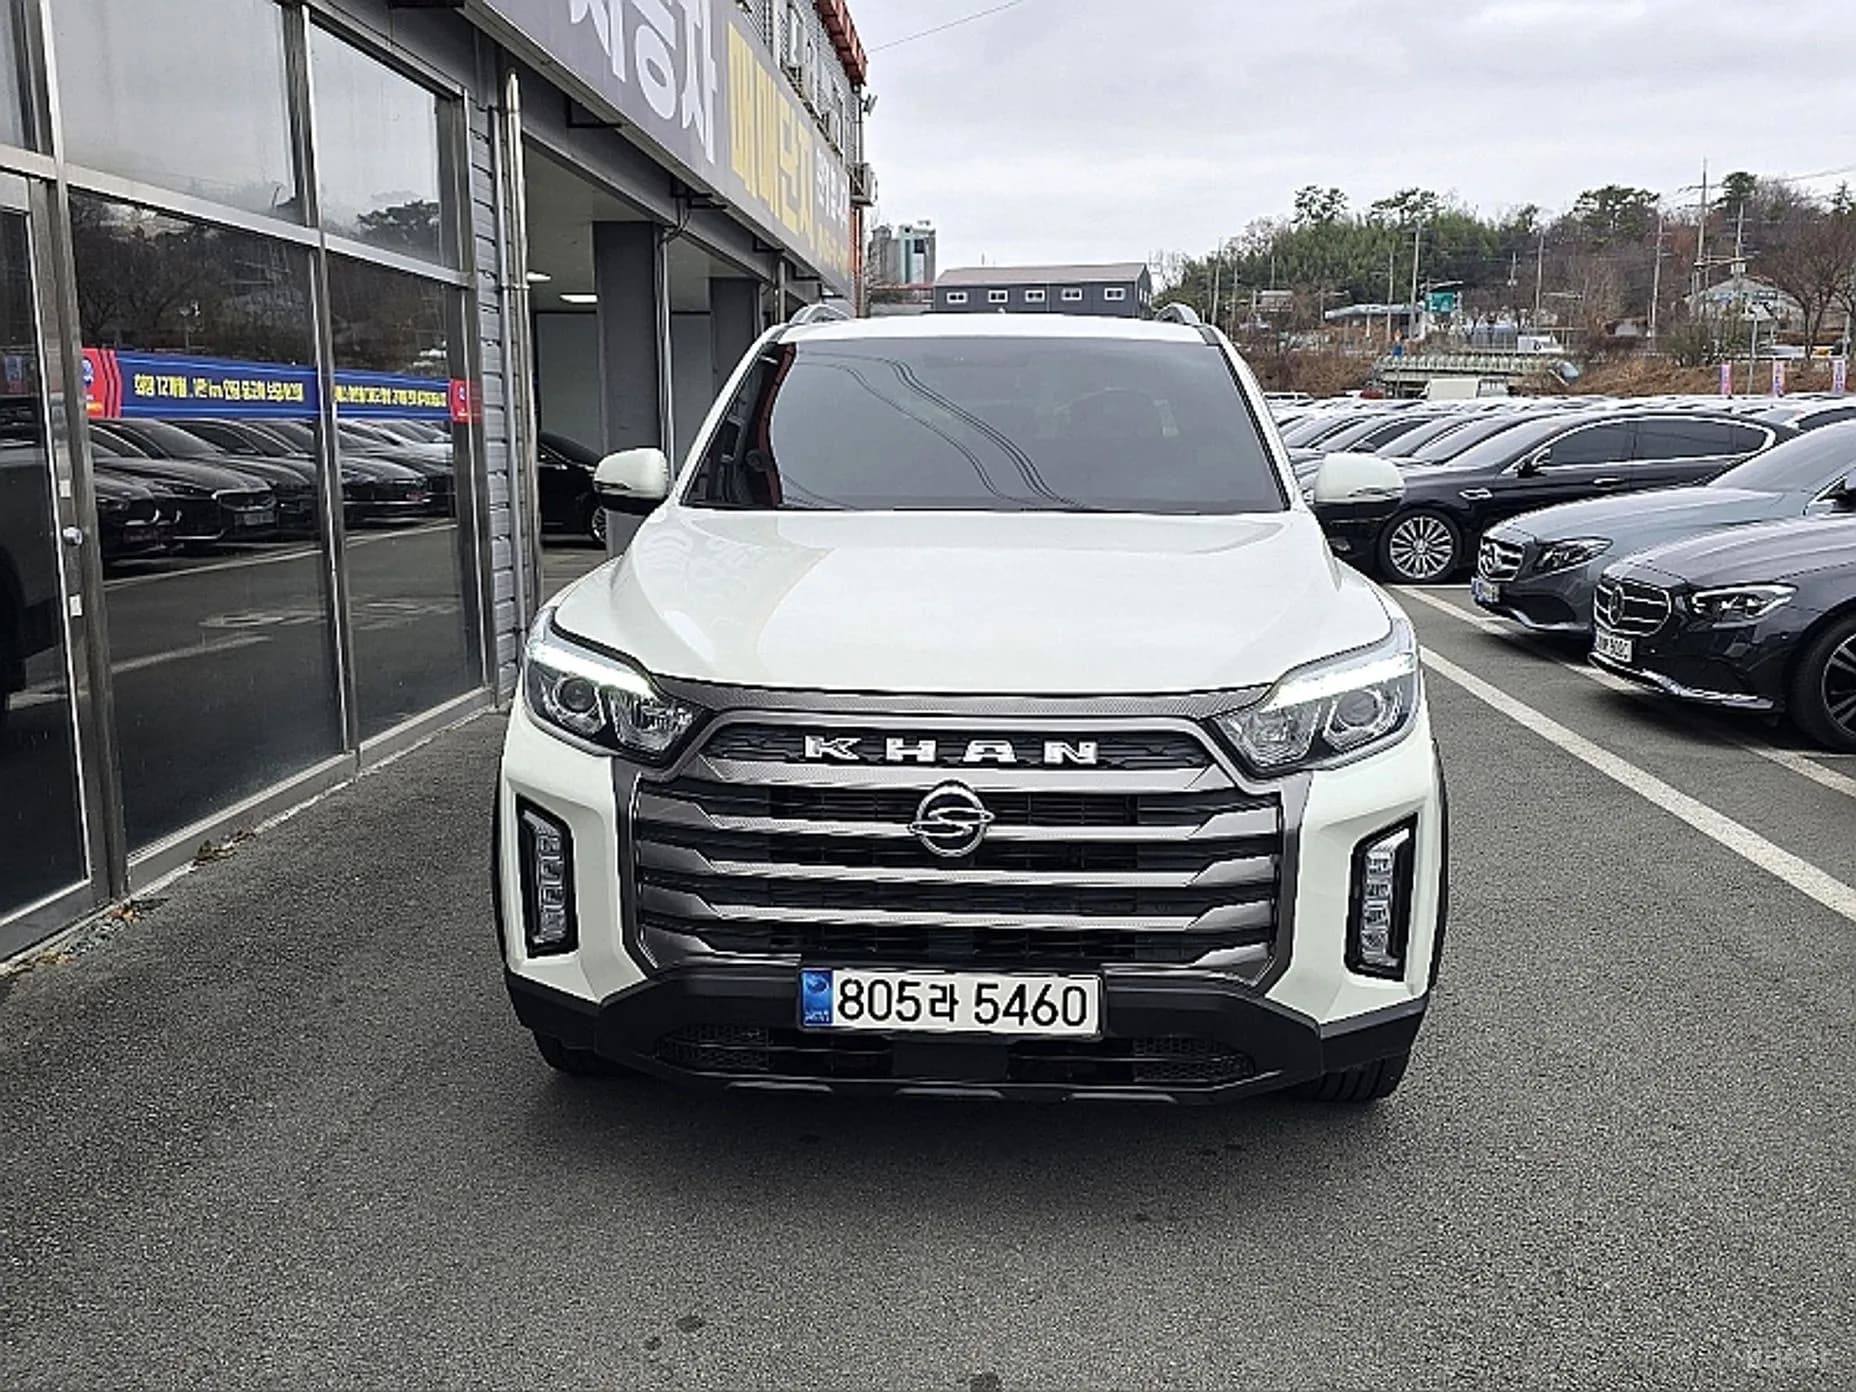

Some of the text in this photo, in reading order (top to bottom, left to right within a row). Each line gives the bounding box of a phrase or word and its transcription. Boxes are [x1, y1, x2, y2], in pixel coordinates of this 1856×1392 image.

[804, 735, 1099, 765] KHAN
[837, 978, 1088, 1027] 805라 5460
